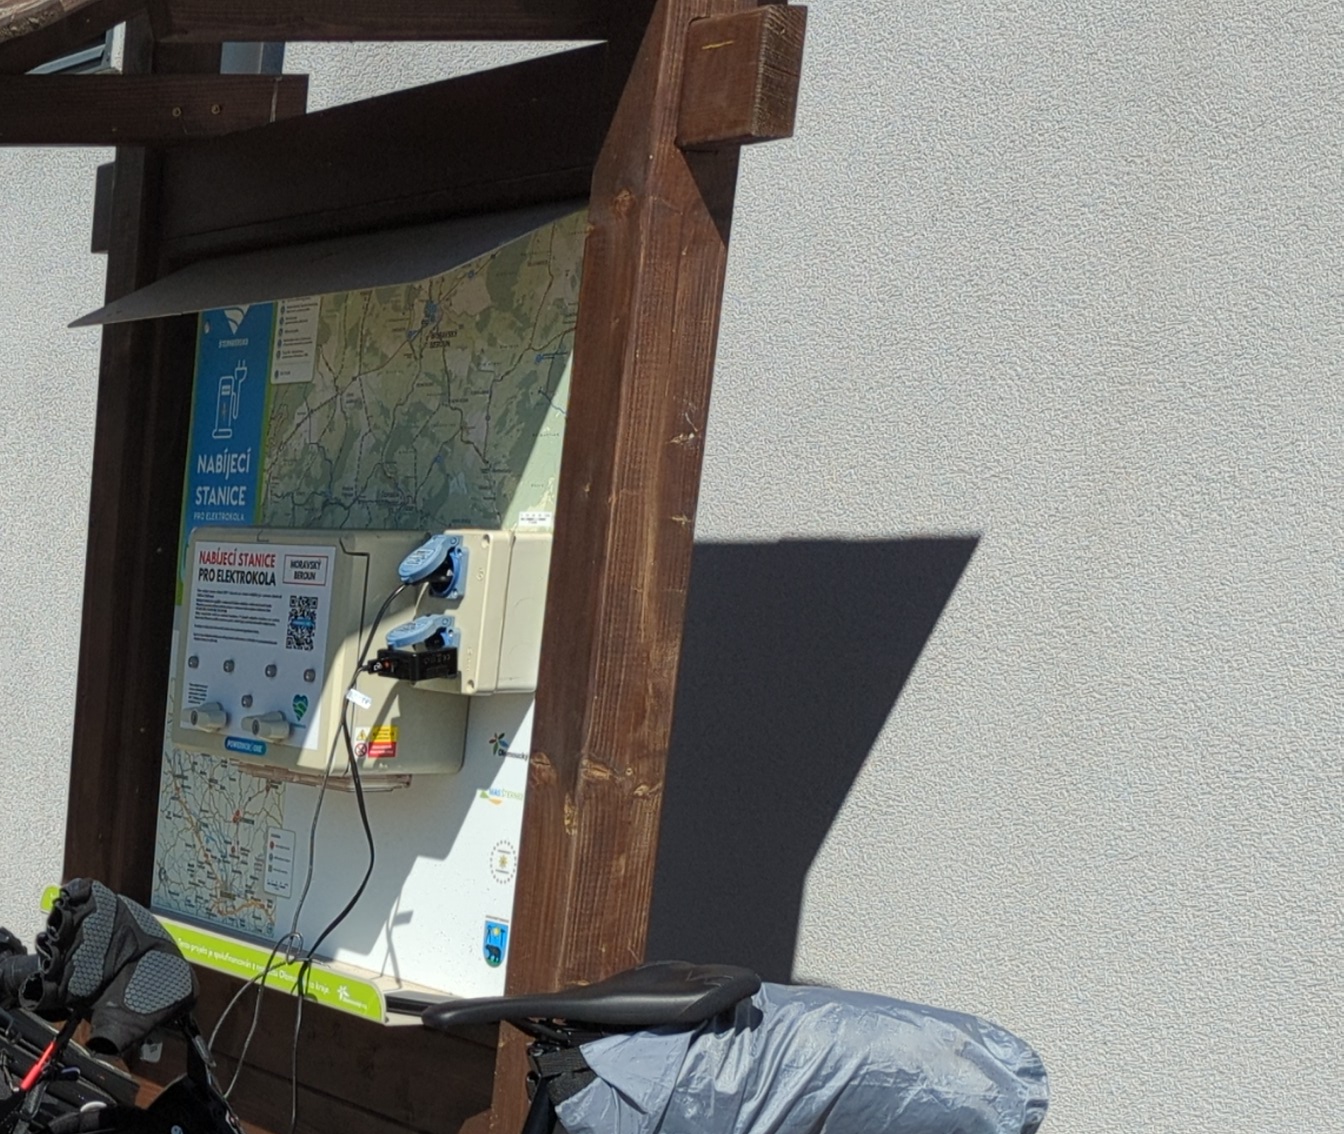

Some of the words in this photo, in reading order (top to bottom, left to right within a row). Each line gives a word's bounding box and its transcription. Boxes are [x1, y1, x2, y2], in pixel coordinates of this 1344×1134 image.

[197, 448, 252, 480] NABÍJECÍ
[195, 486, 247, 506] STANICE
[193, 511, 205, 521] PRO
[206, 511, 245, 522] ELEKTROKOLA
[199, 547, 237, 567] NABÍJECÍ
[238, 554, 276, 568] STANICE
[198, 568, 215, 583] PRO
[216, 568, 276, 586] ELEKTROKOLA
